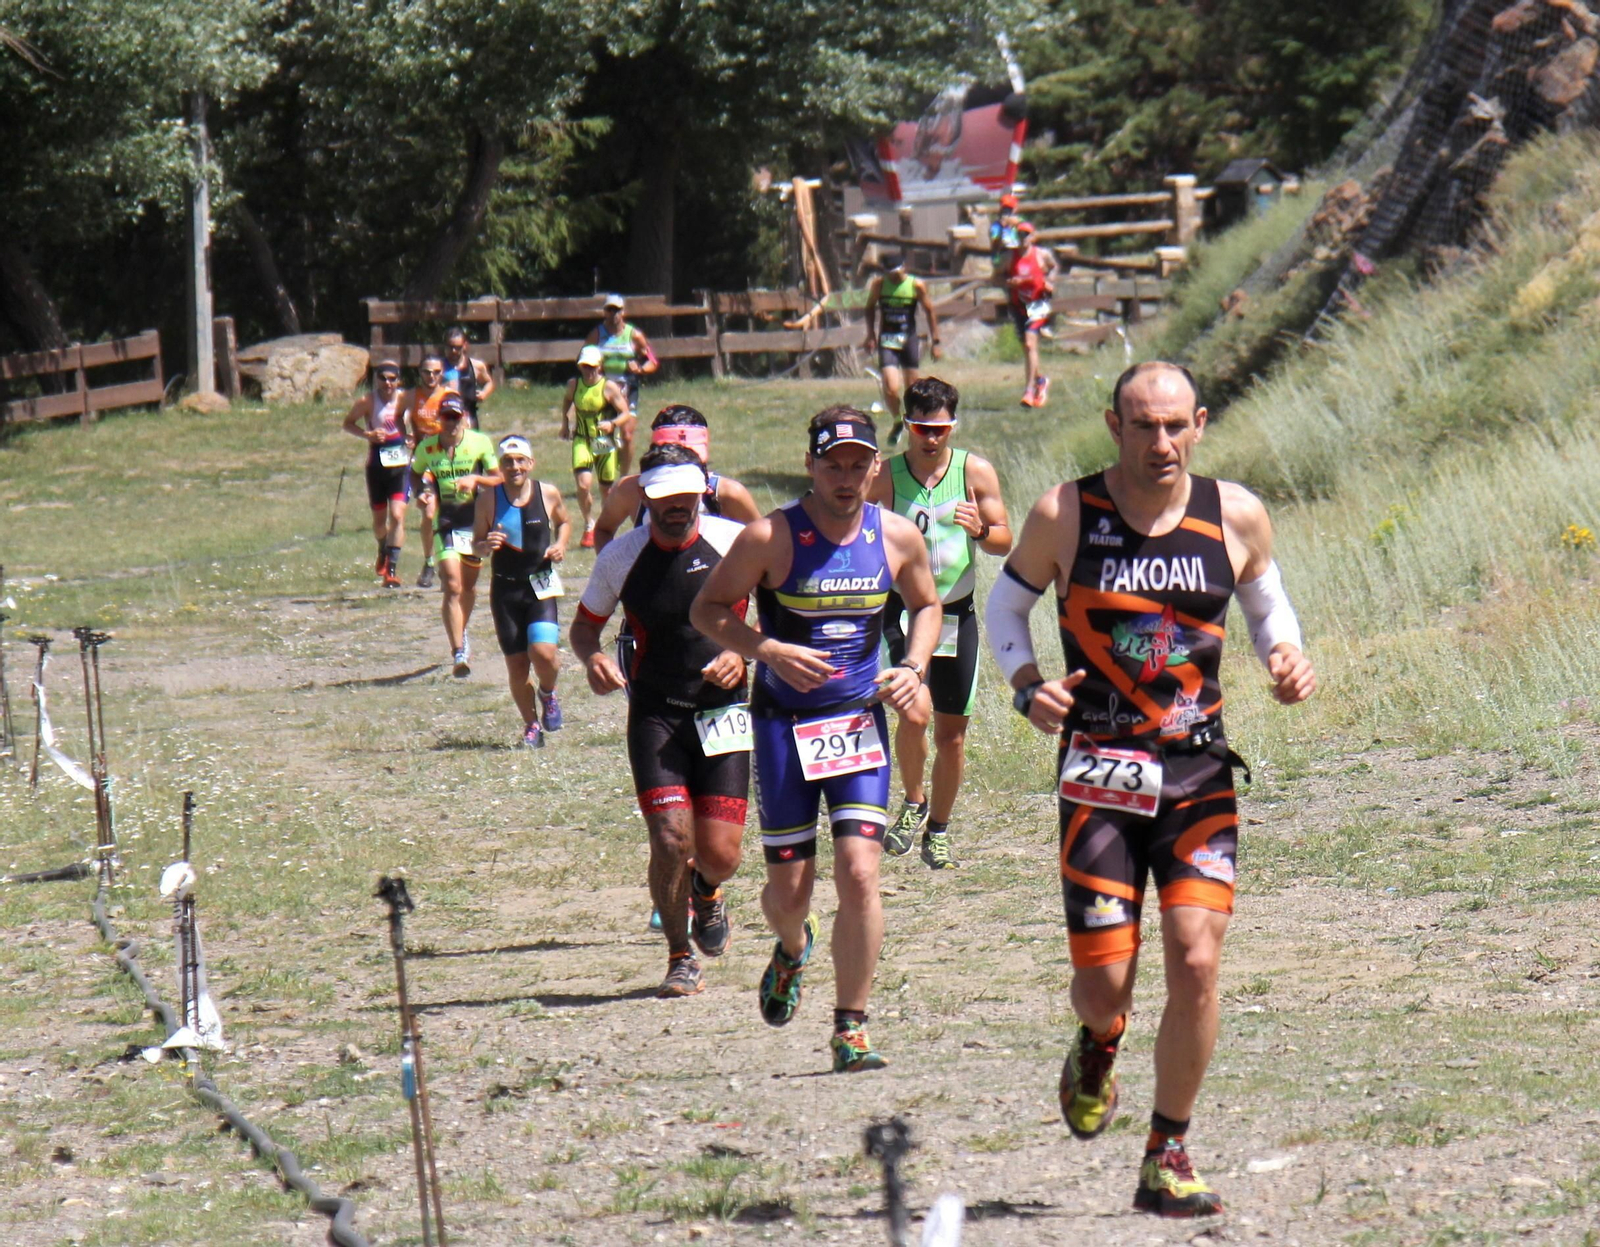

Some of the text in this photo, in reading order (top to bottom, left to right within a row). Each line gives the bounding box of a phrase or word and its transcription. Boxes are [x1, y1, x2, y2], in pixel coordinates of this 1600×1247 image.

[820, 565, 885, 592] GUADIX
[1099, 556, 1207, 593] PAKOAVI
[707, 713, 747, 738] 119
[1081, 692, 1145, 732] avalon
[810, 730, 862, 761] 297
[1074, 754, 1143, 792] 273
